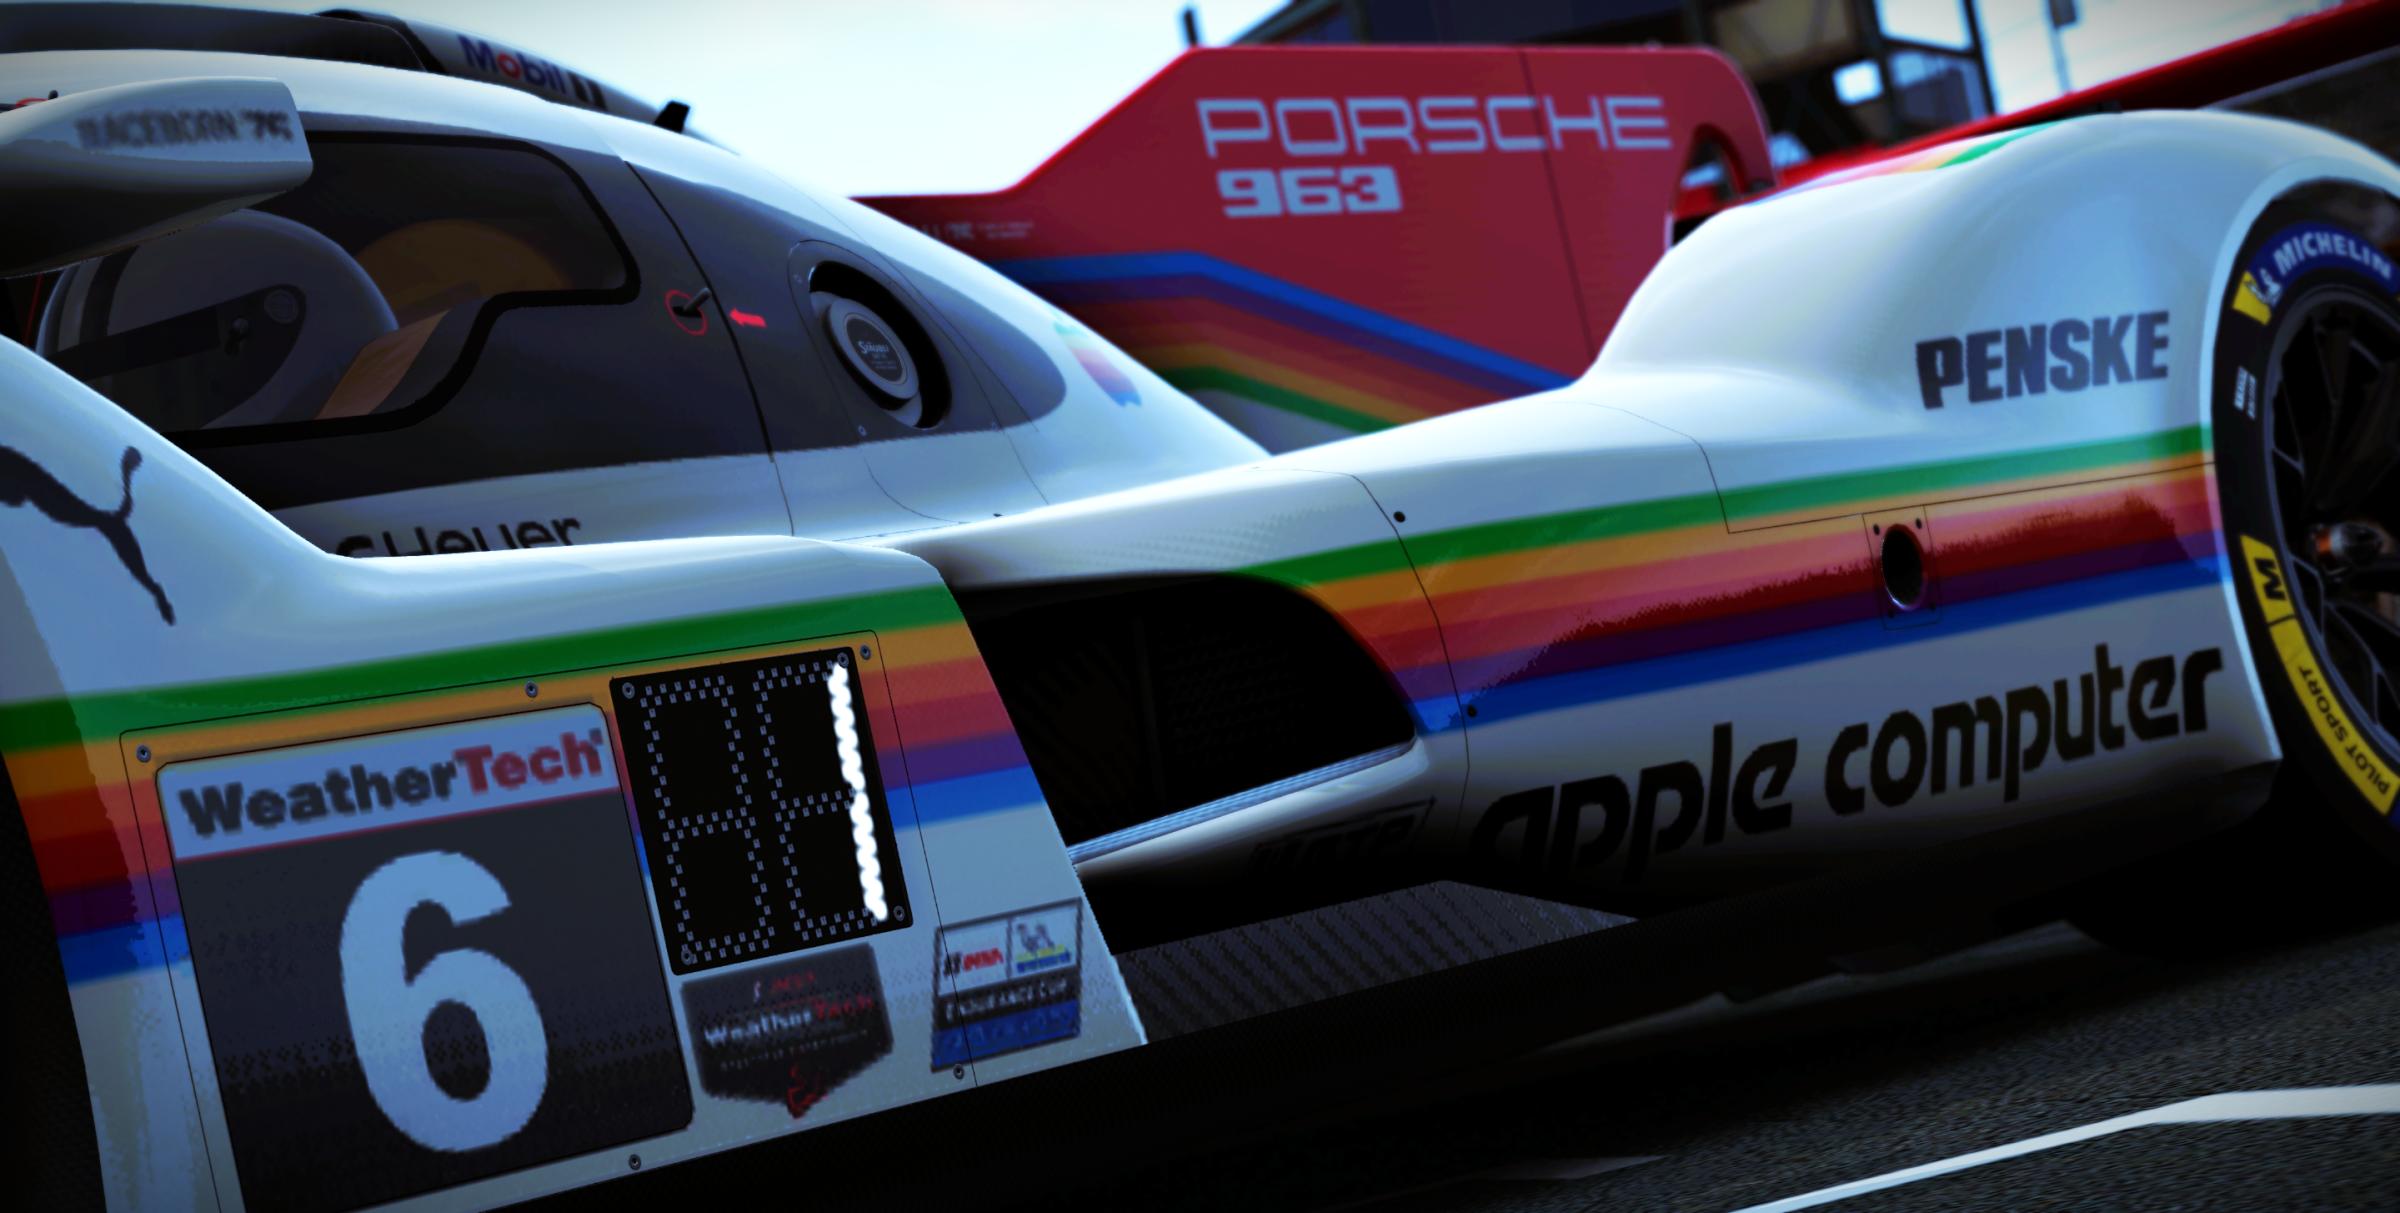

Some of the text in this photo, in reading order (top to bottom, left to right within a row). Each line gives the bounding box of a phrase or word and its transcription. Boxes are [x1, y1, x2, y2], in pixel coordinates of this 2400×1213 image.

[458, 33, 567, 94] Mobil
[1196, 96, 1672, 157] PORSCHE
[1216, 165, 1403, 217] 963
[2273, 231, 2392, 280] MICHELIN
[1915, 310, 2170, 410] PENSKE
[1468, 643, 2222, 885] apple computer
[2298, 665, 2391, 797] PILOT SPORT
[179, 728, 604, 837] WeatherTech
[339, 849, 549, 1153] 6
